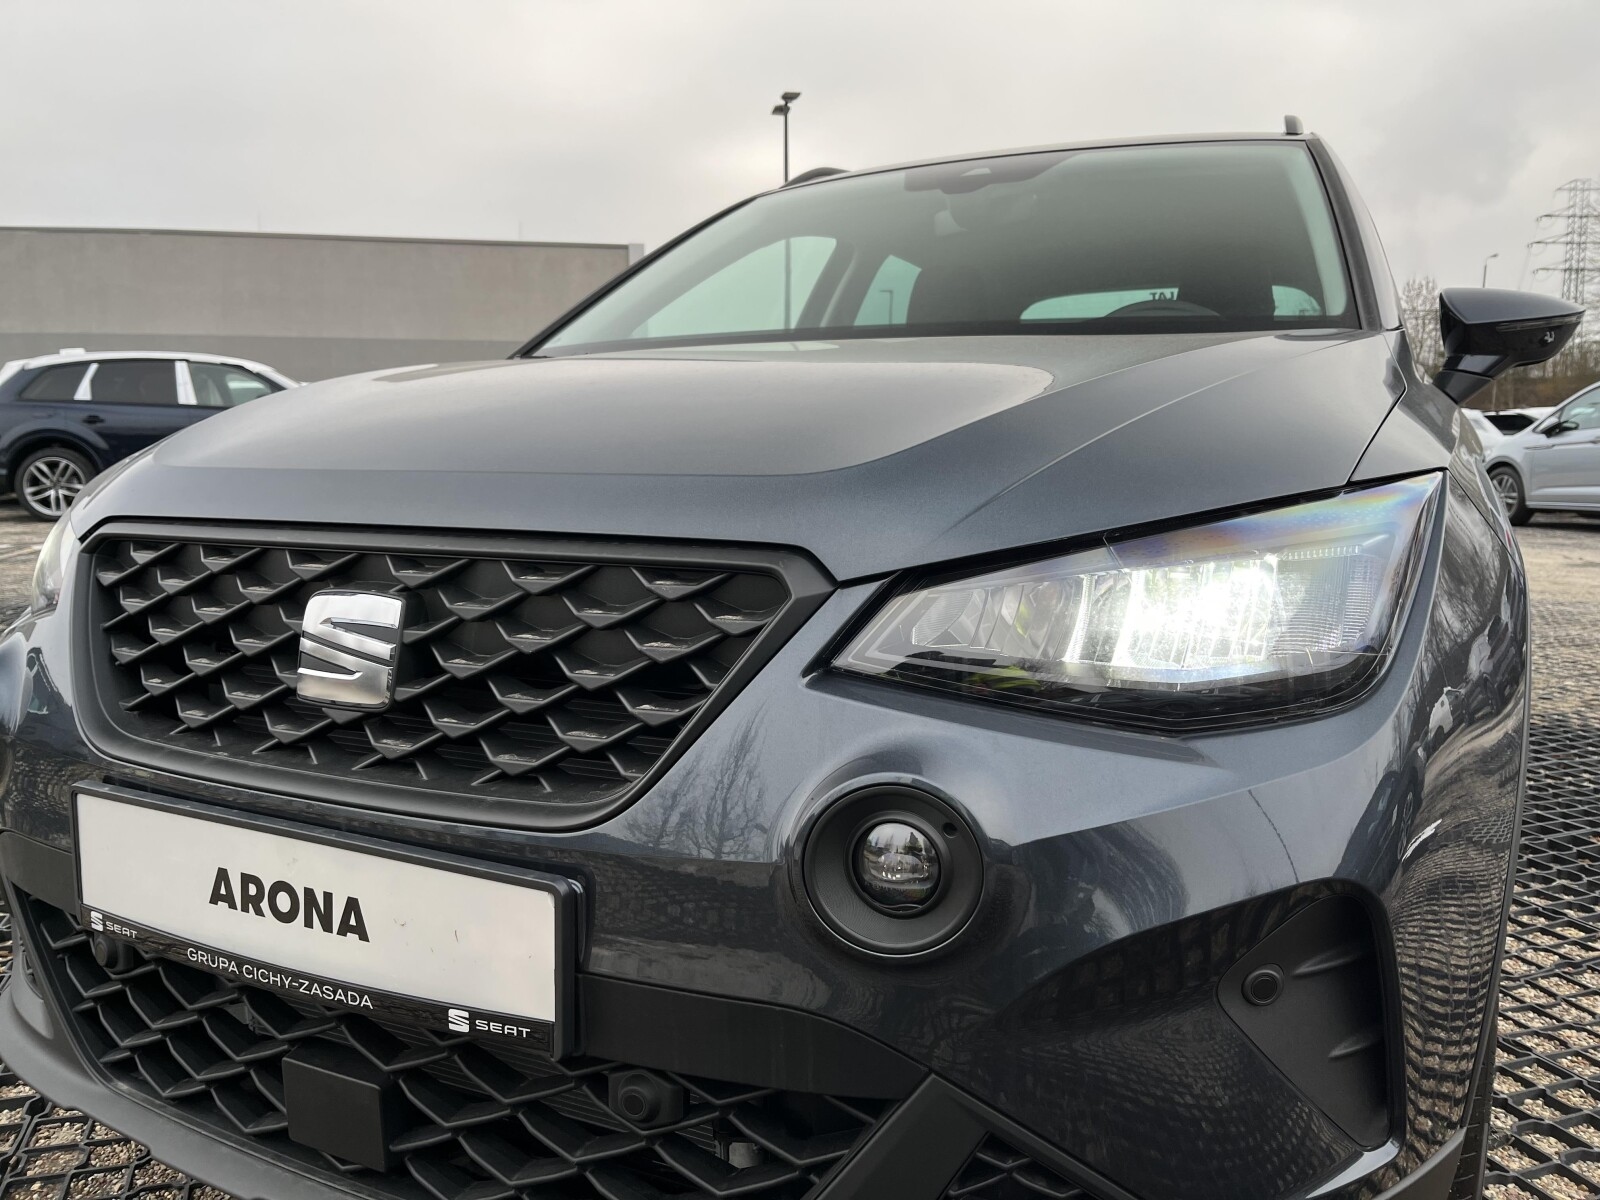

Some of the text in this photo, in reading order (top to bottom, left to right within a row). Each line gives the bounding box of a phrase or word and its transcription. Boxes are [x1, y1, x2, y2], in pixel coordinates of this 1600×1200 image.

[208, 866, 371, 943] ARONA
[105, 921, 138, 939] SEAT
[187, 947, 374, 1010] GRUPA CICHY-ZASADA
[475, 1019, 531, 1038] SEAT
